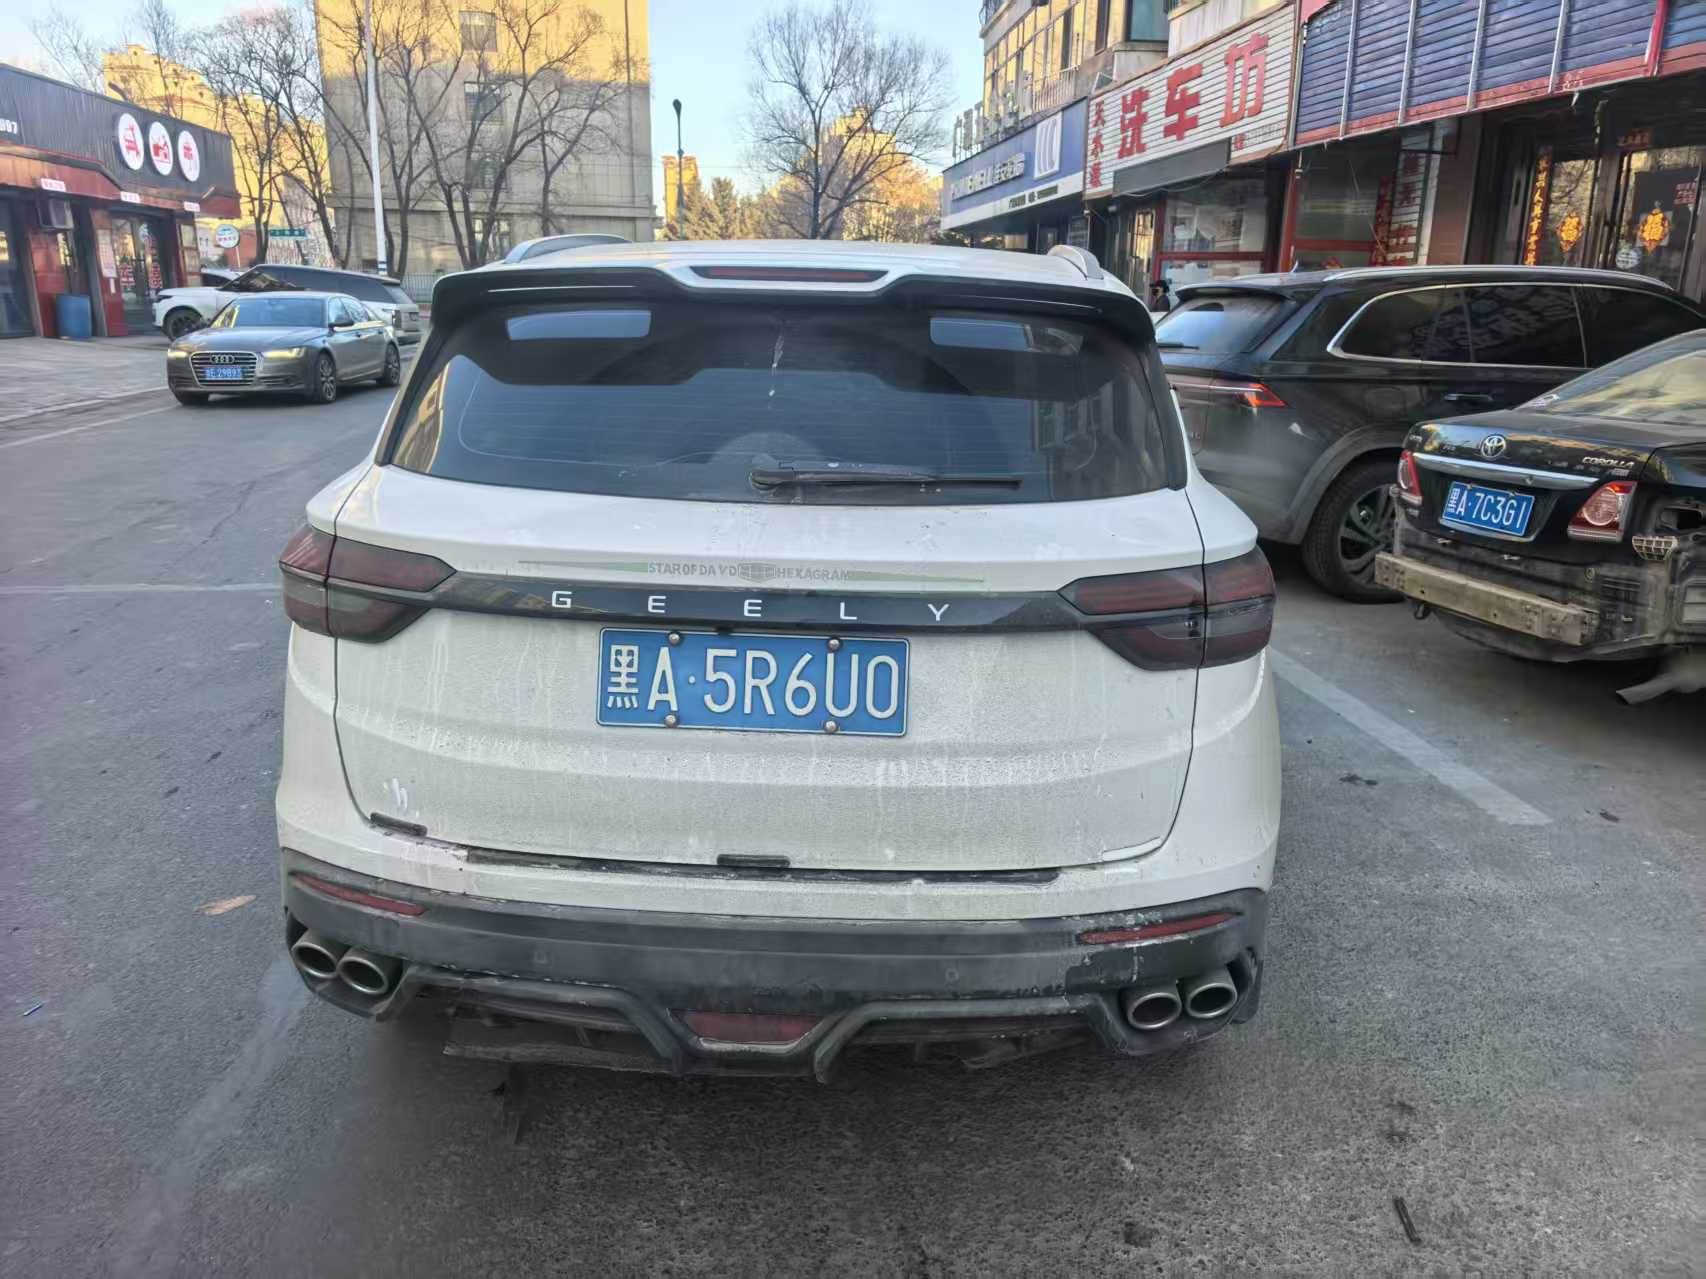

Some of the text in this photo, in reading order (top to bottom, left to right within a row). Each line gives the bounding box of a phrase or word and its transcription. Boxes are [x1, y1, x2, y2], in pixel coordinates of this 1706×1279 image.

[1117, 32, 1270, 160] 洗车坊
[551, 590, 949, 621] GEELY
